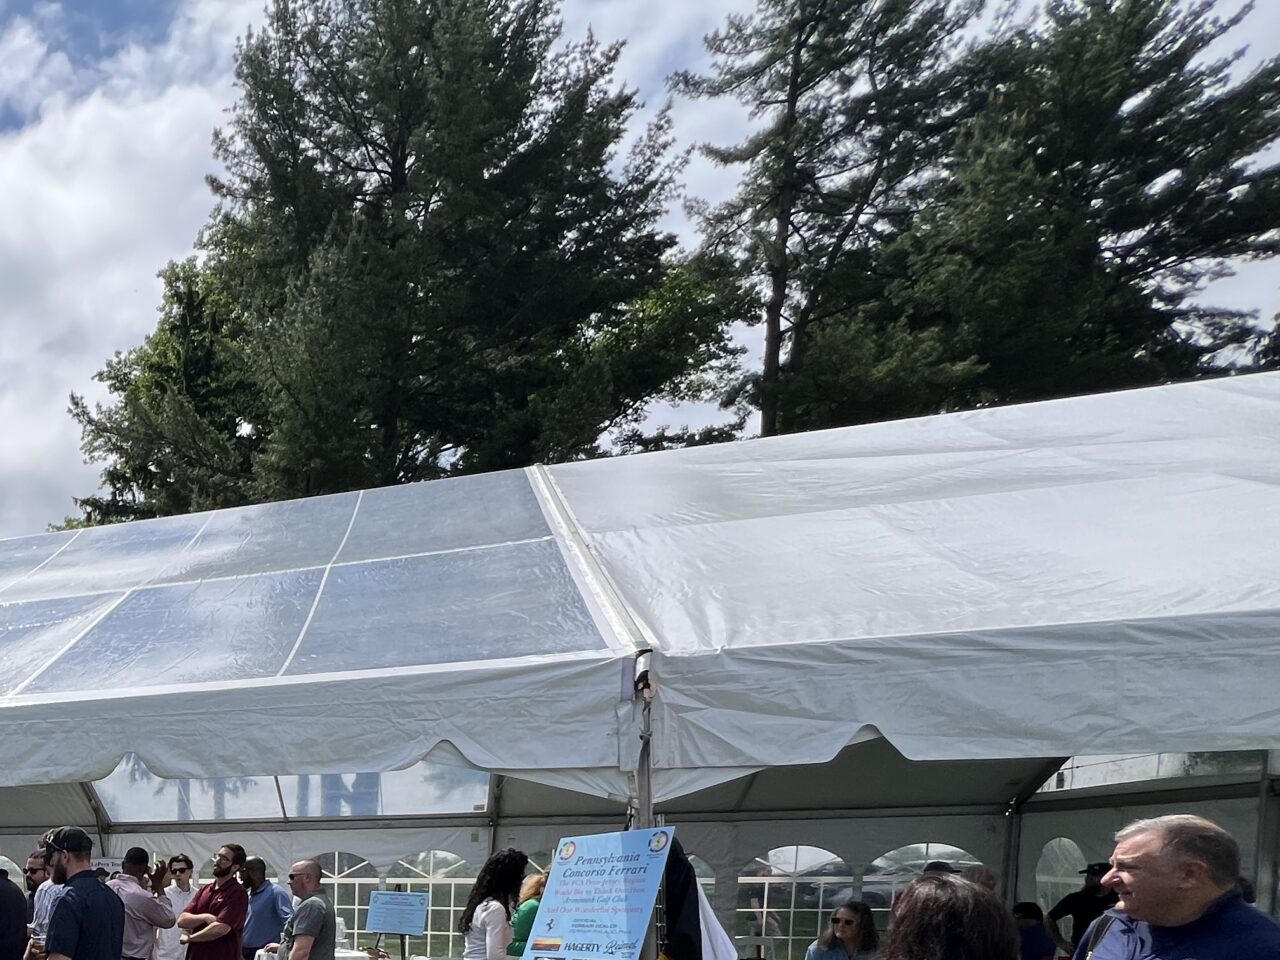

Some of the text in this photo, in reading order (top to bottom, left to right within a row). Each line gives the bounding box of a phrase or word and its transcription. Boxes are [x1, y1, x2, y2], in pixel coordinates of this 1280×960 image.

[574, 852, 641, 866] Pennsylvania
[562, 863, 649, 879] Concorso Ferrari
[564, 943, 601, 952] HAGERTY
